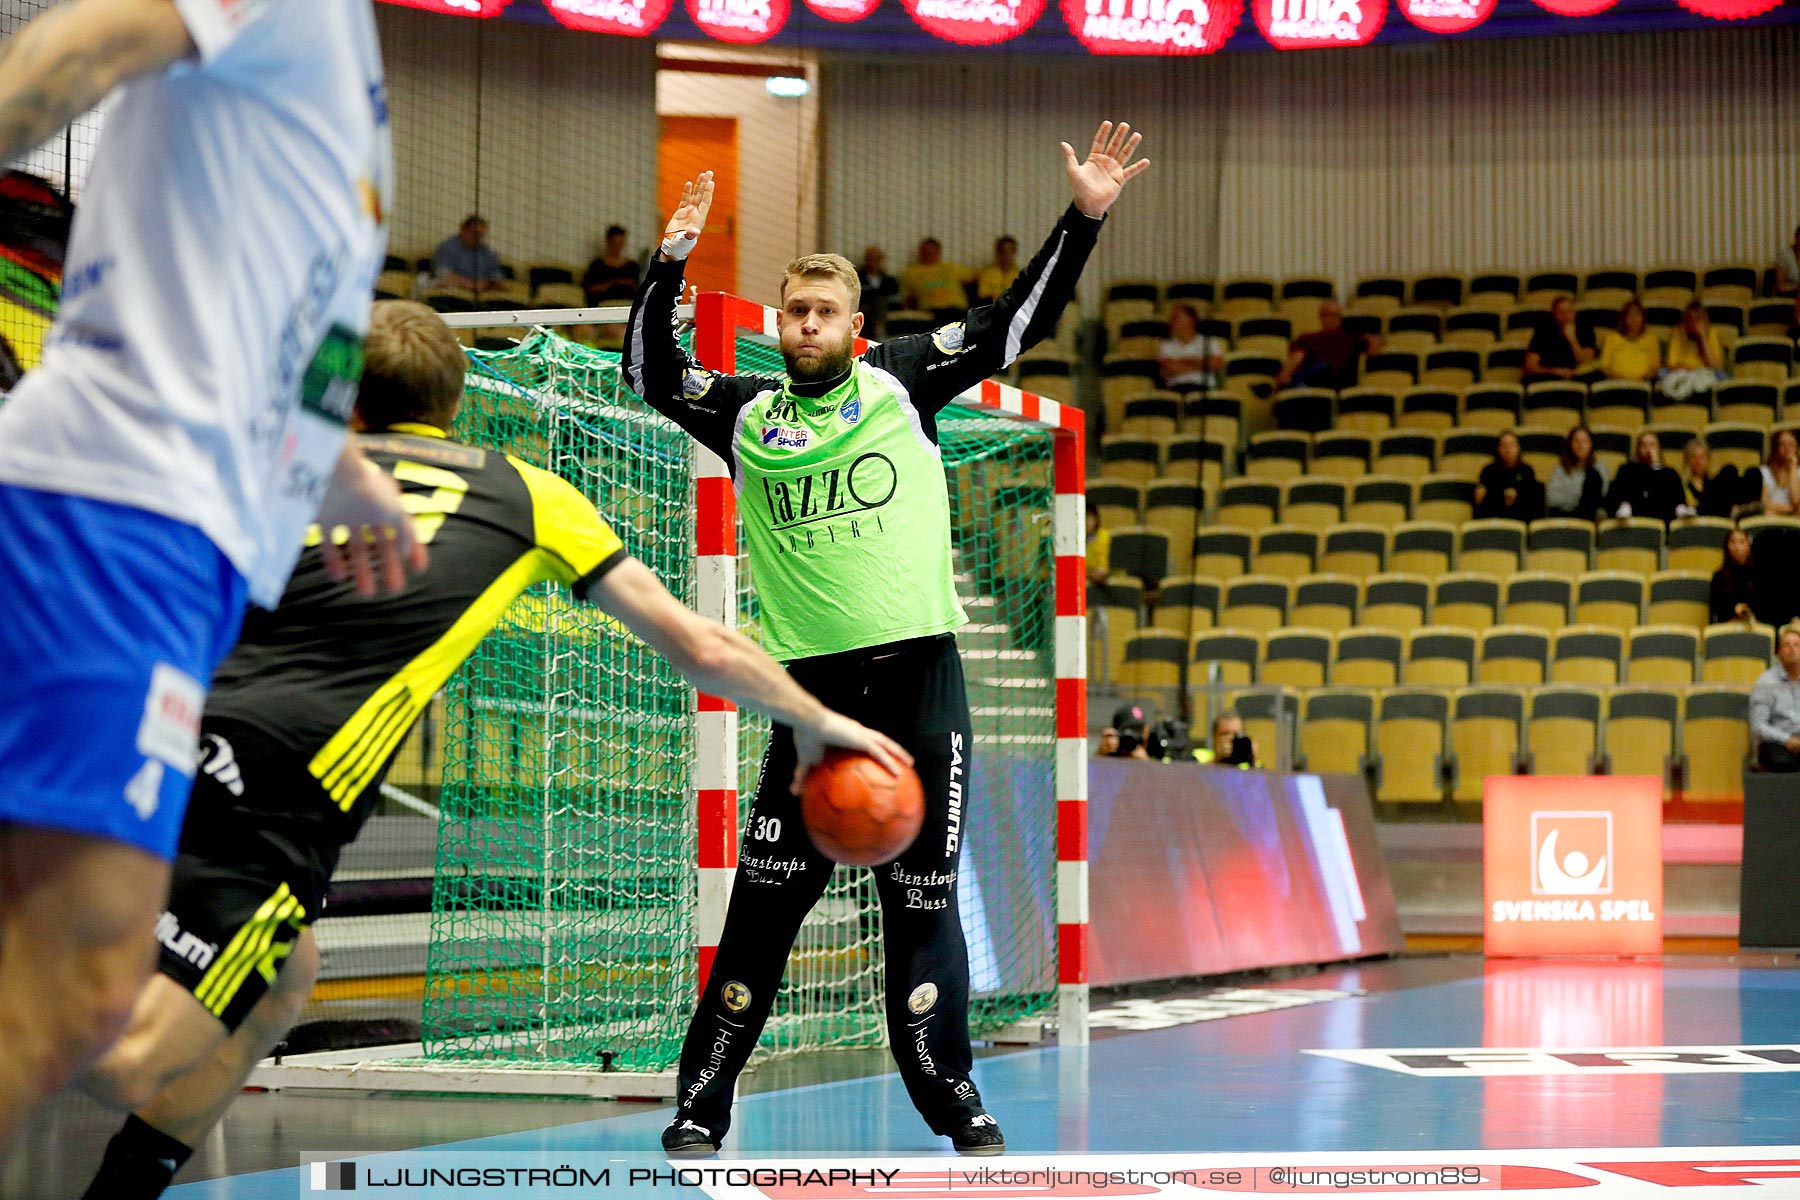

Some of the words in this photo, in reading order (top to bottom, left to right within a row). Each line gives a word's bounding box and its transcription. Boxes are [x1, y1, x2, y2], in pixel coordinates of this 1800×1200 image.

[1083, 16, 1207, 48] MEGAPOL
[777, 437, 808, 447] SPORT
[779, 427, 808, 439] INTER
[754, 815, 782, 842] 30
[905, 888, 948, 910] Buss
[1492, 900, 1596, 922] SVENSKA
[1600, 900, 1655, 922] SPEL
[683, 1028, 733, 1109] Holmgrens
